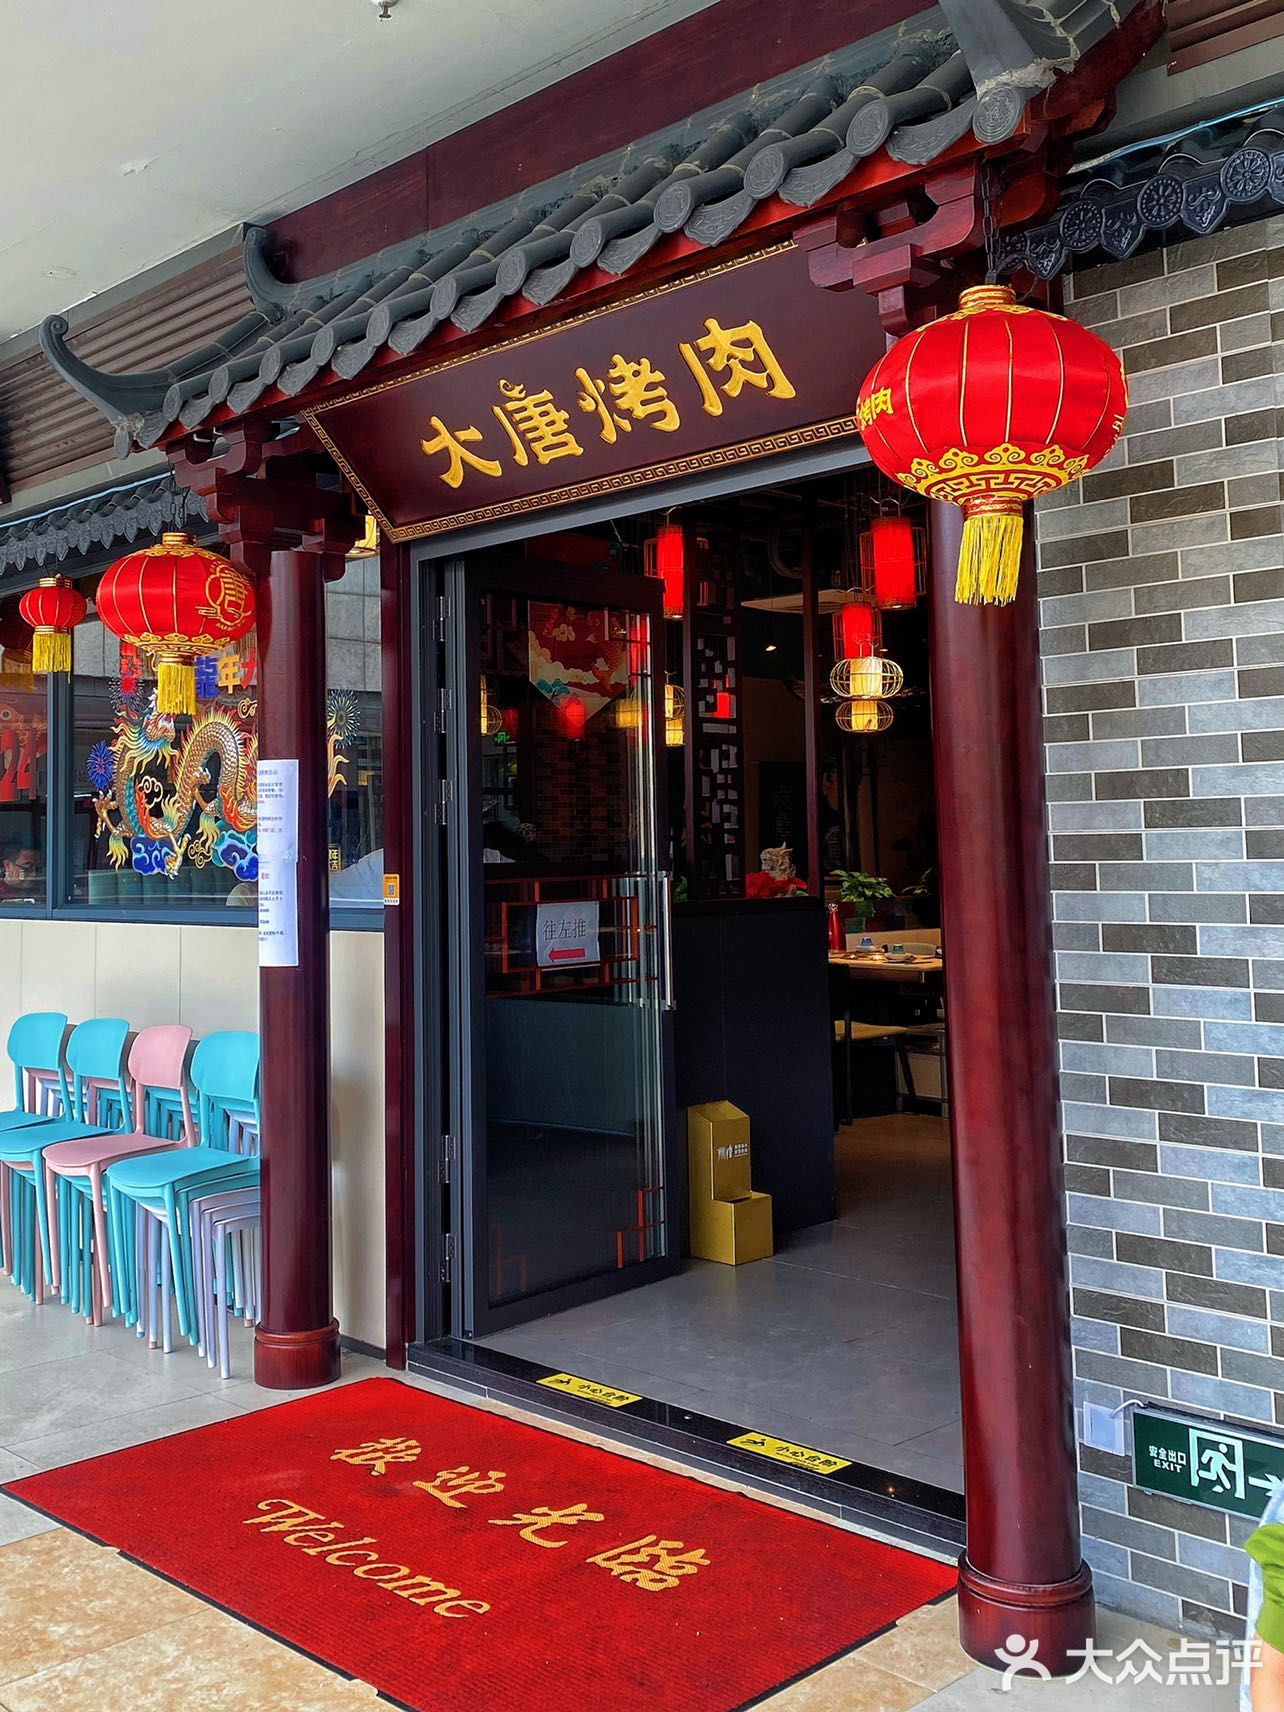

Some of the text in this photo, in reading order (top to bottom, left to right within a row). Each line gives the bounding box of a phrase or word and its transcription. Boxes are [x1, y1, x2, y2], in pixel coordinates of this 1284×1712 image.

[420, 317, 797, 490] 大唐烤肉
[857, 386, 894, 431] 烤肉
[543, 917, 586, 941] 往左推
[1148, 1445, 1187, 1466] 安全出口
[1153, 1459, 1182, 1473] EXIT
[242, 1498, 491, 1618] Welcome
